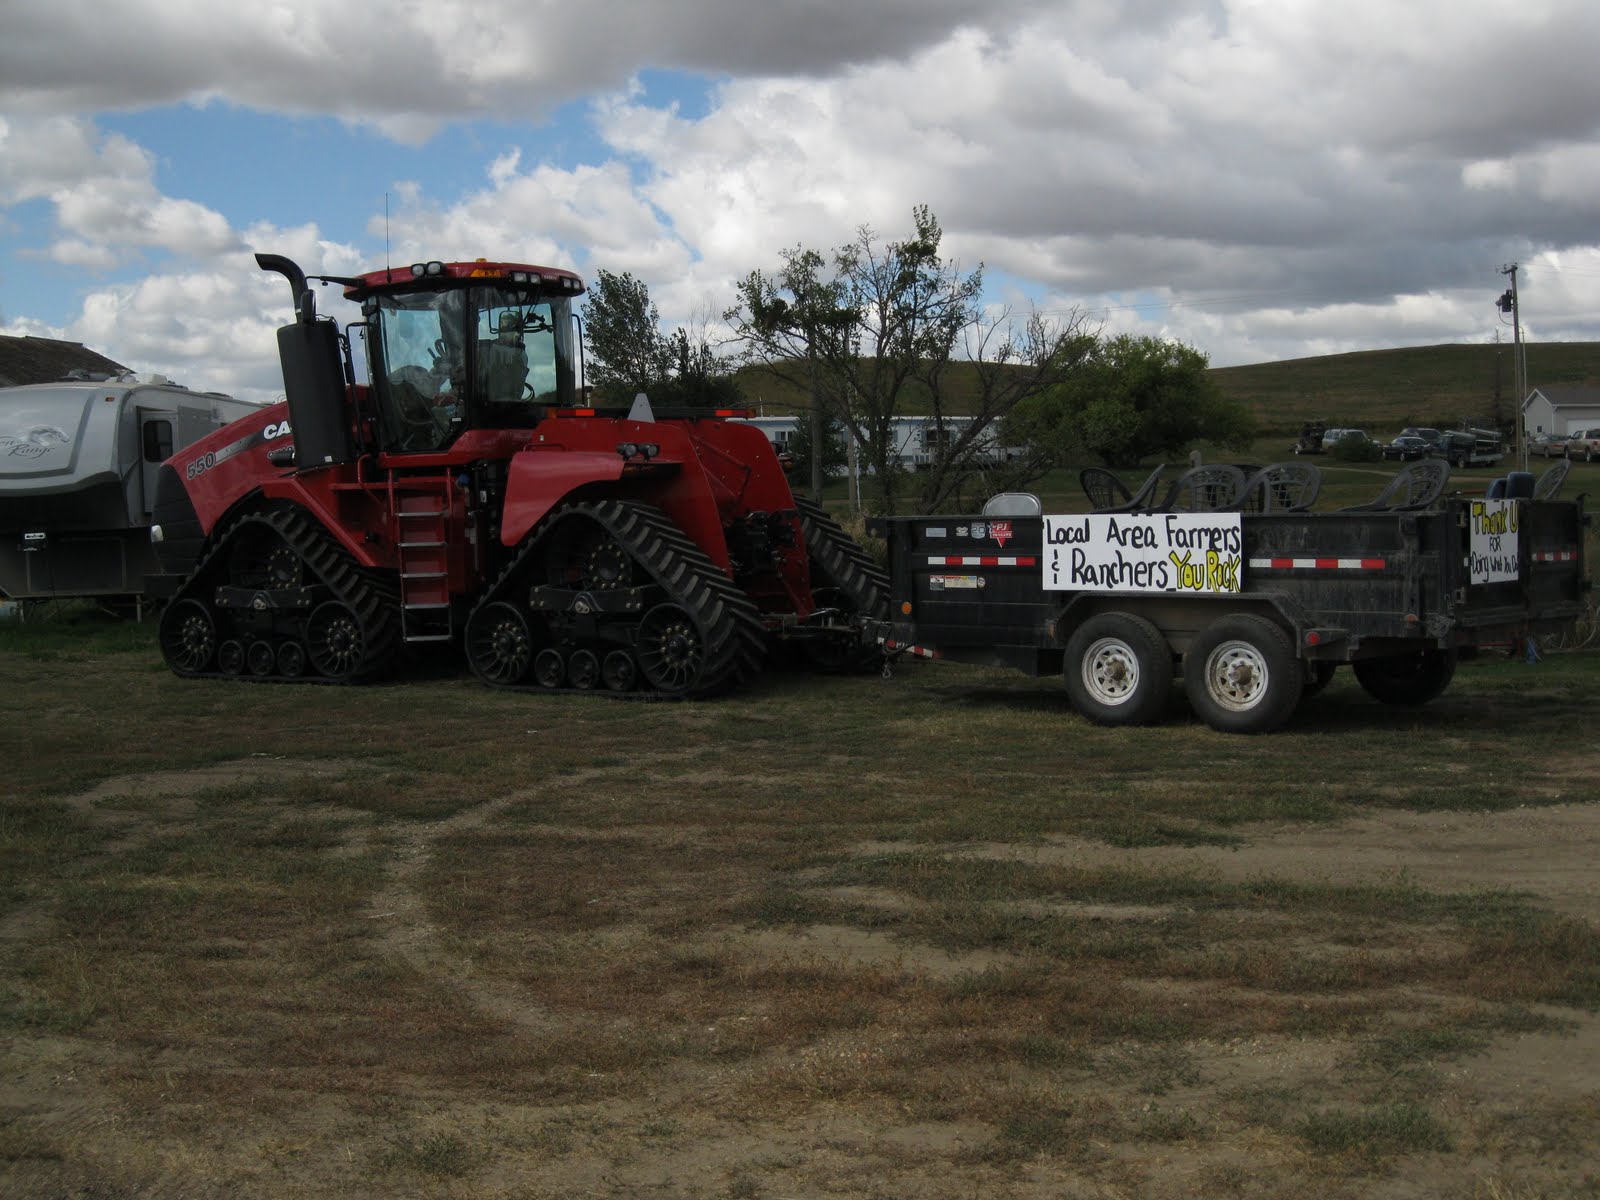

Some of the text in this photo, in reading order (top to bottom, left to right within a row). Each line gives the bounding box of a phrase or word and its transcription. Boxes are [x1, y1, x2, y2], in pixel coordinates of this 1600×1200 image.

[263, 420, 293, 440] CA
[8, 443, 55, 459] Range
[187, 452, 216, 480] 550
[971, 526, 986, 534] 20
[996, 523, 1008, 531] PJ
[1472, 501, 1508, 535] Thank
[1046, 515, 1241, 554] Local Area Farmers
[1489, 536, 1502, 552] FOR
[1071, 548, 1168, 588] Ranchers
[1472, 551, 1489, 582] Doing
